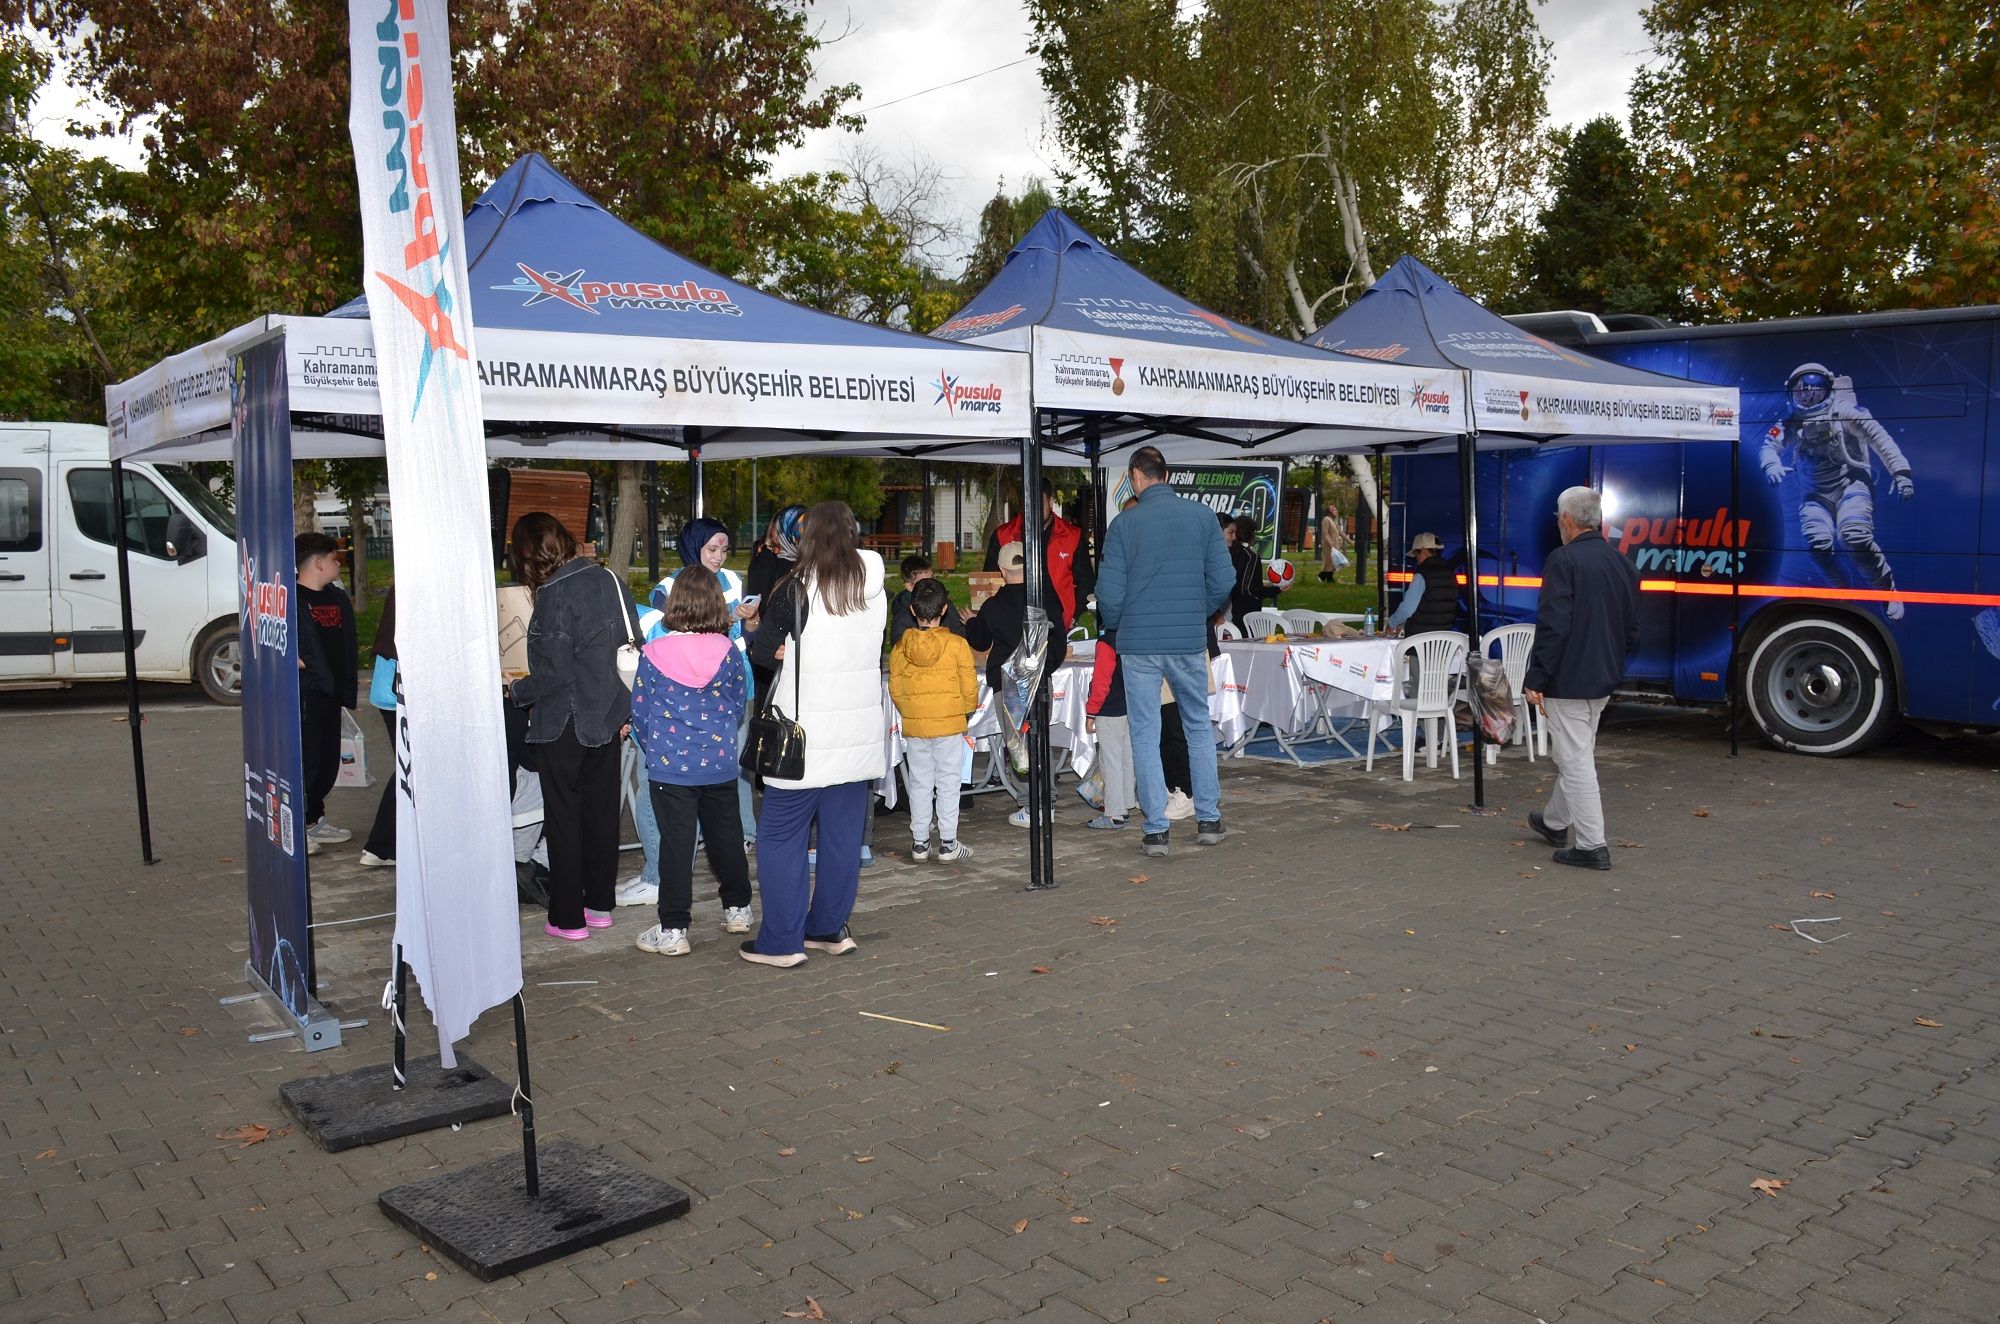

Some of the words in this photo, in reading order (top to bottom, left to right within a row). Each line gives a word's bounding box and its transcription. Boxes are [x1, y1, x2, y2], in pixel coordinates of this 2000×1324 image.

[578, 280, 732, 304] pusula
[303, 359, 378, 375] Kahramanm
[1053, 364, 1110, 380] Kahramanmaraş
[303, 375, 355, 387] Büyükşehir
[476, 360, 668, 398] AHRAMANMARAŞ
[673, 364, 804, 402] BÜYÜKŞEHİR
[809, 373, 916, 403] BELEDİYESİ
[1138, 366, 1260, 399] KAHRAMANMARAŞ
[1262, 373, 1336, 403] BÜYÜKŞEHİR
[1339, 379, 1400, 406] BELEDİYESİ
[953, 383, 1002, 405] pusula
[1421, 390, 1449, 408] pusula
[960, 400, 1002, 414] maraş
[1537, 397, 1611, 420] KAHRAMANMARAŞ
[1613, 400, 1660, 422] BÜYÜKŞEHİR
[1661, 401, 1701, 422] BELEDİYESİ
[1196, 471, 1244, 486] BELEDİYESİ
[1618, 507, 1751, 555] pusula
